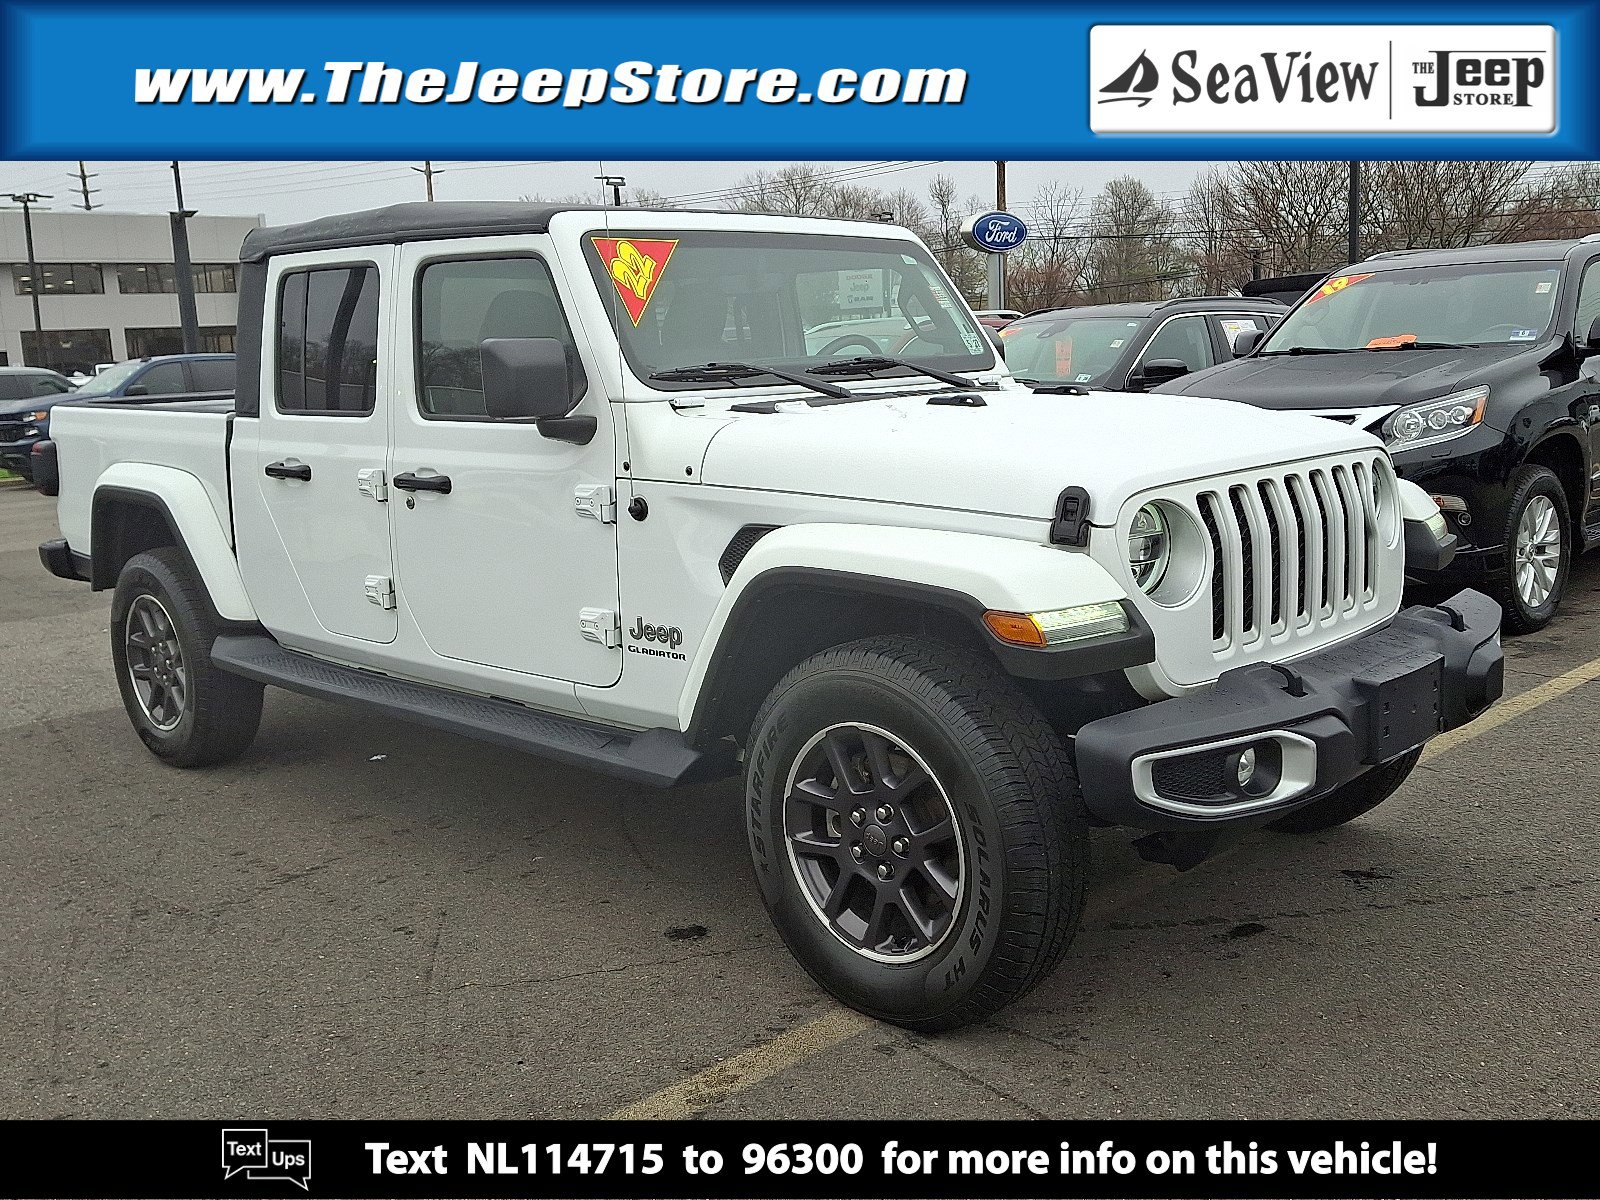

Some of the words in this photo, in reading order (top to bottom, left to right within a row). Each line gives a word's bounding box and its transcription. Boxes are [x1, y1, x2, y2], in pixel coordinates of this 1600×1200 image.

[985, 220, 1017, 243] Ford
[610, 241, 656, 300] 22
[629, 616, 682, 650] Jeep
[628, 645, 686, 661] GLADIATOR
[964, 801, 991, 957] SOLARUS
